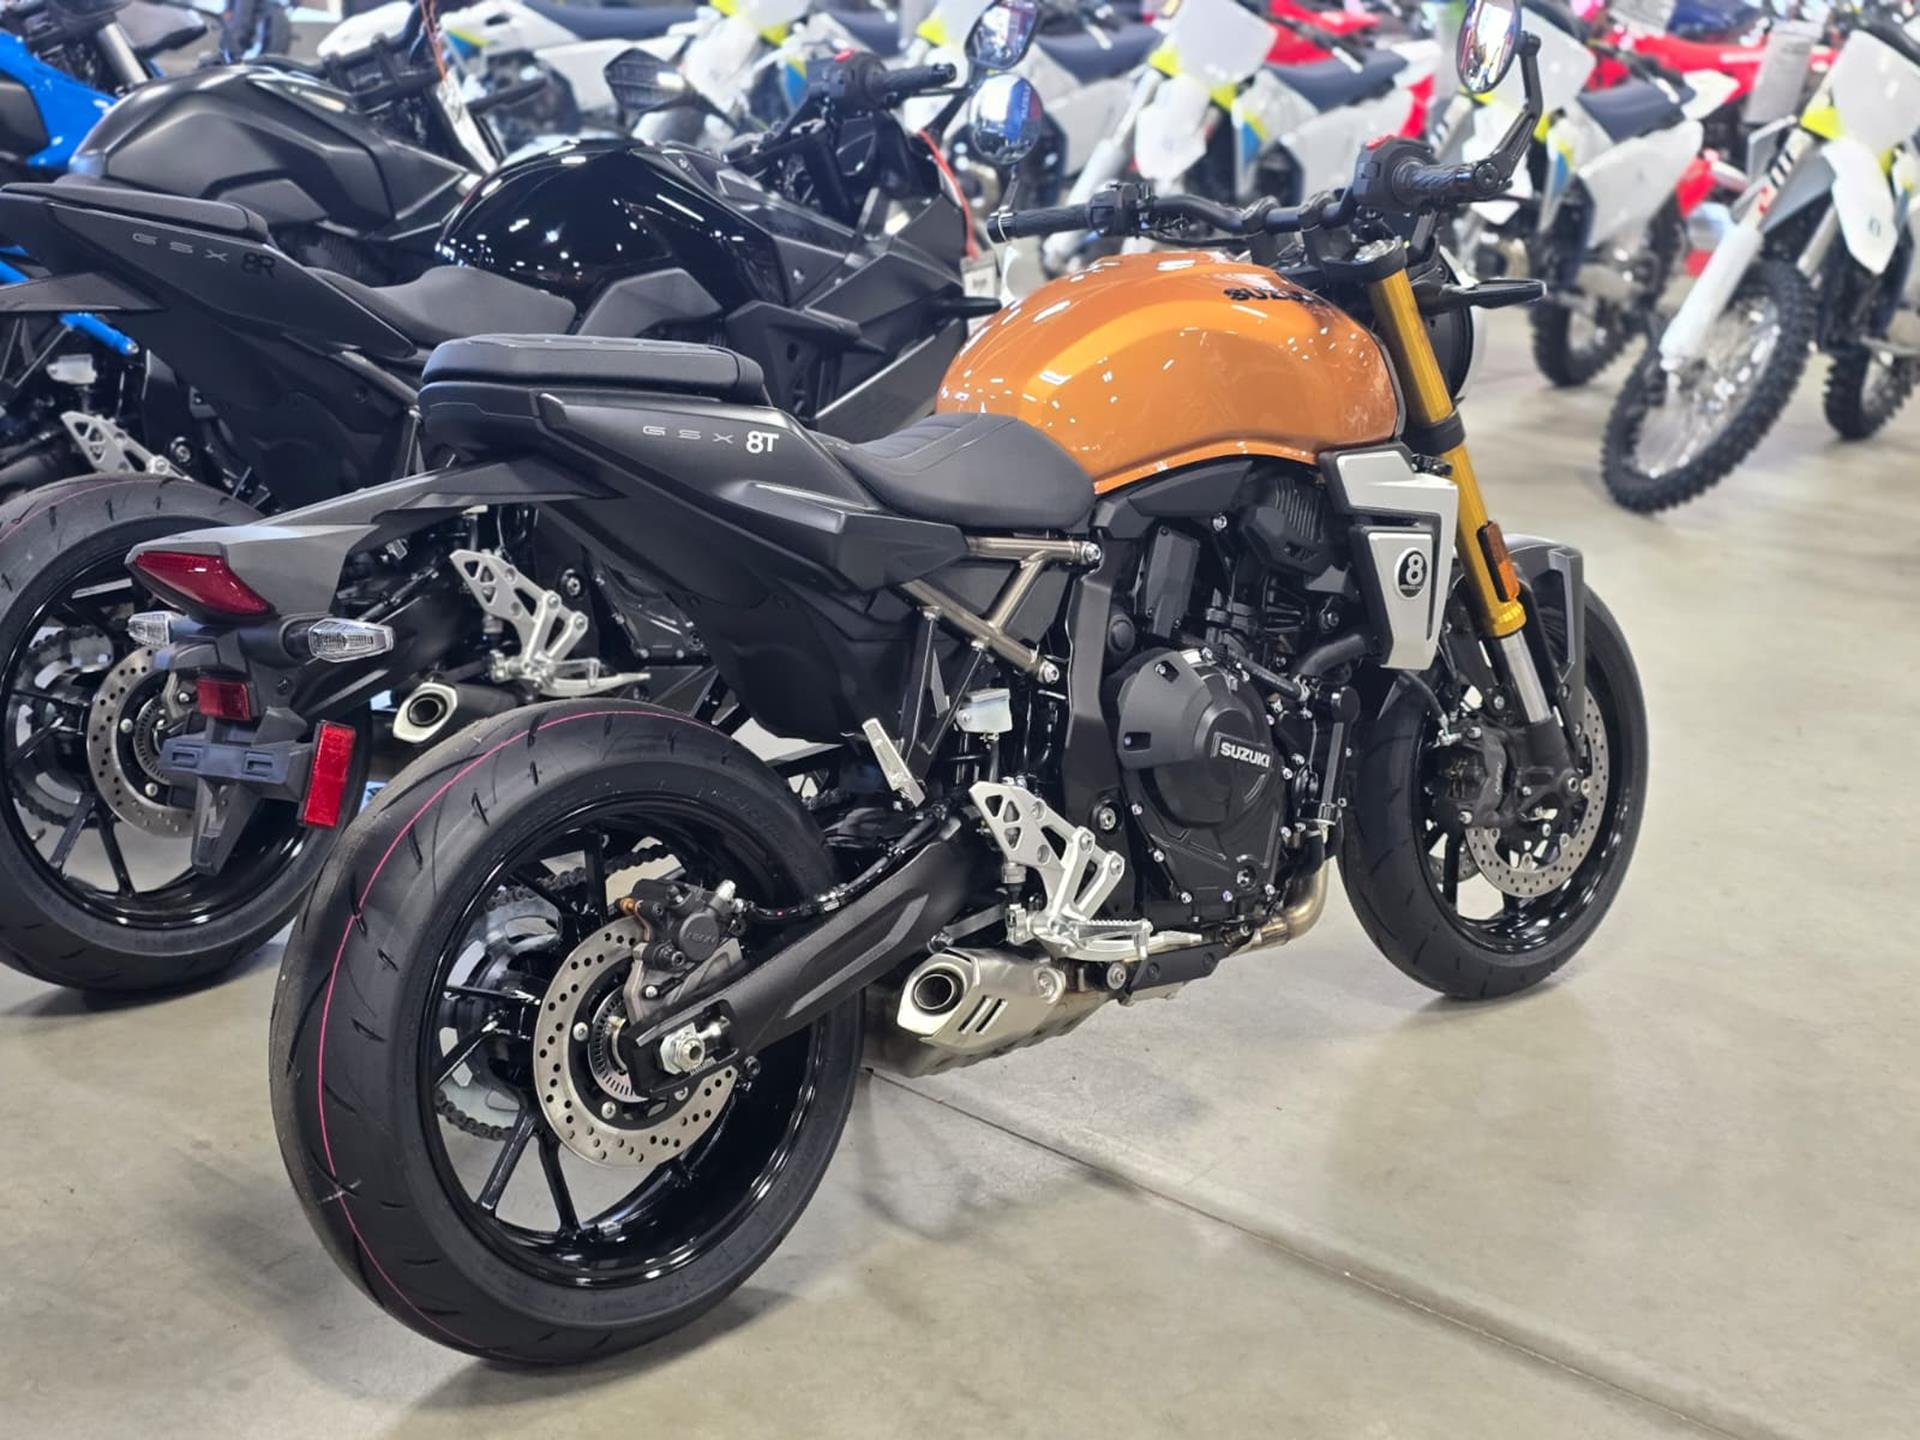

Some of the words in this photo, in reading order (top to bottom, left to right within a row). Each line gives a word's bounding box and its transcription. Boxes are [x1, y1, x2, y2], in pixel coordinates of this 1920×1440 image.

[132, 232, 228, 262] GSX
[642, 425, 734, 444] GSX
[745, 430, 780, 454] 8T
[1405, 553, 1425, 585] 8
[1219, 741, 1271, 768] SUZUKI
